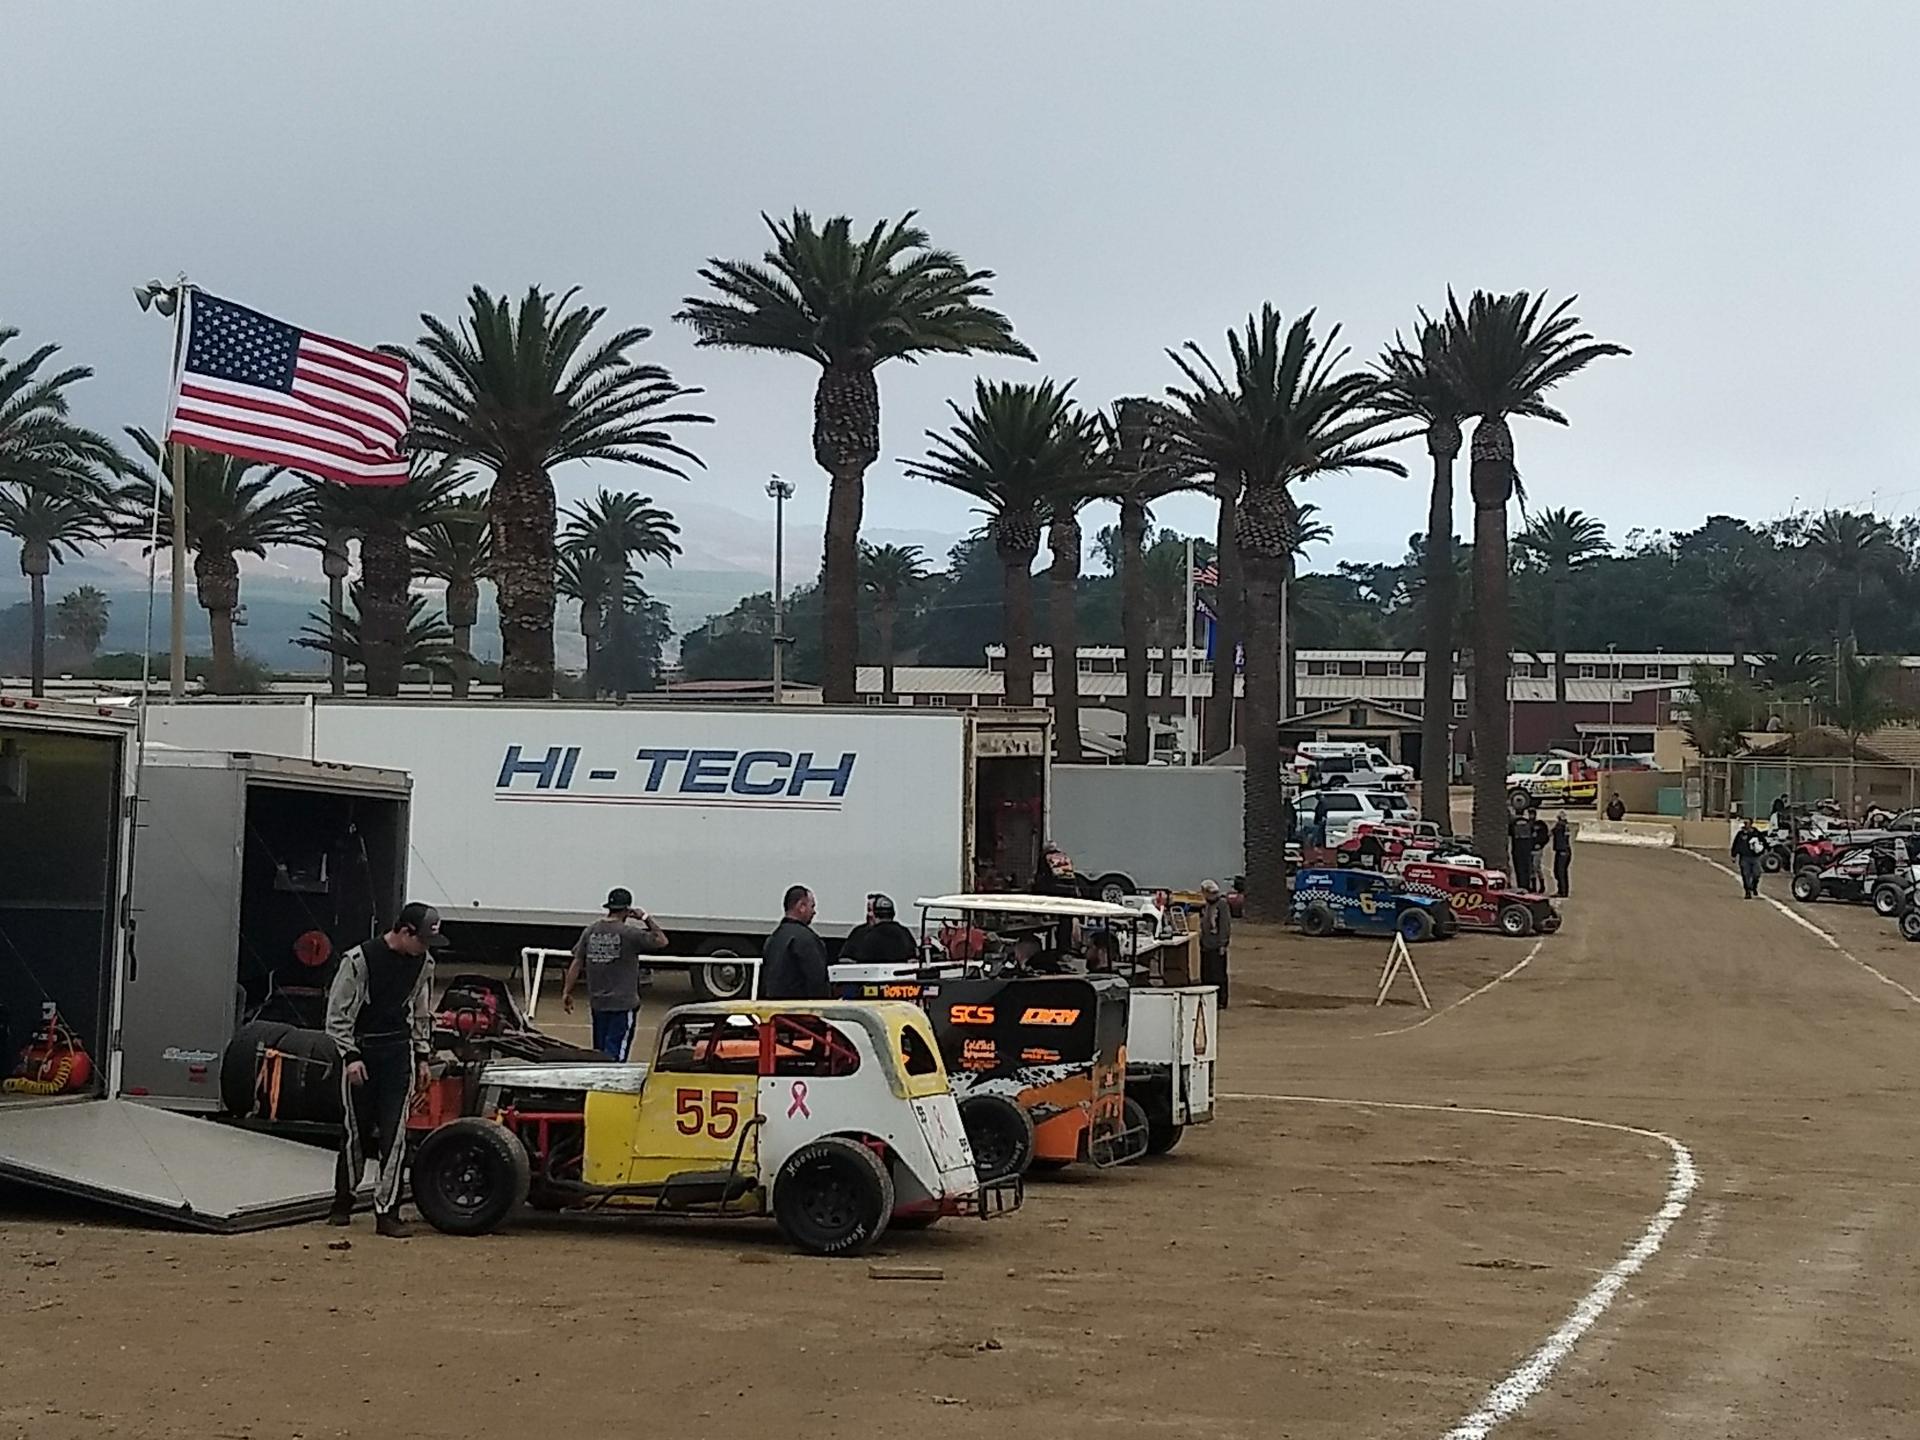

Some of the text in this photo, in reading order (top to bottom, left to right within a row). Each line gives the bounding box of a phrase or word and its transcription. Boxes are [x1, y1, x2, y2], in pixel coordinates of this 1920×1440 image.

[494, 744, 583, 790] HI
[635, 747, 858, 798] TECH
[950, 1004, 996, 1025] SCS
[675, 1087, 739, 1140] 55
